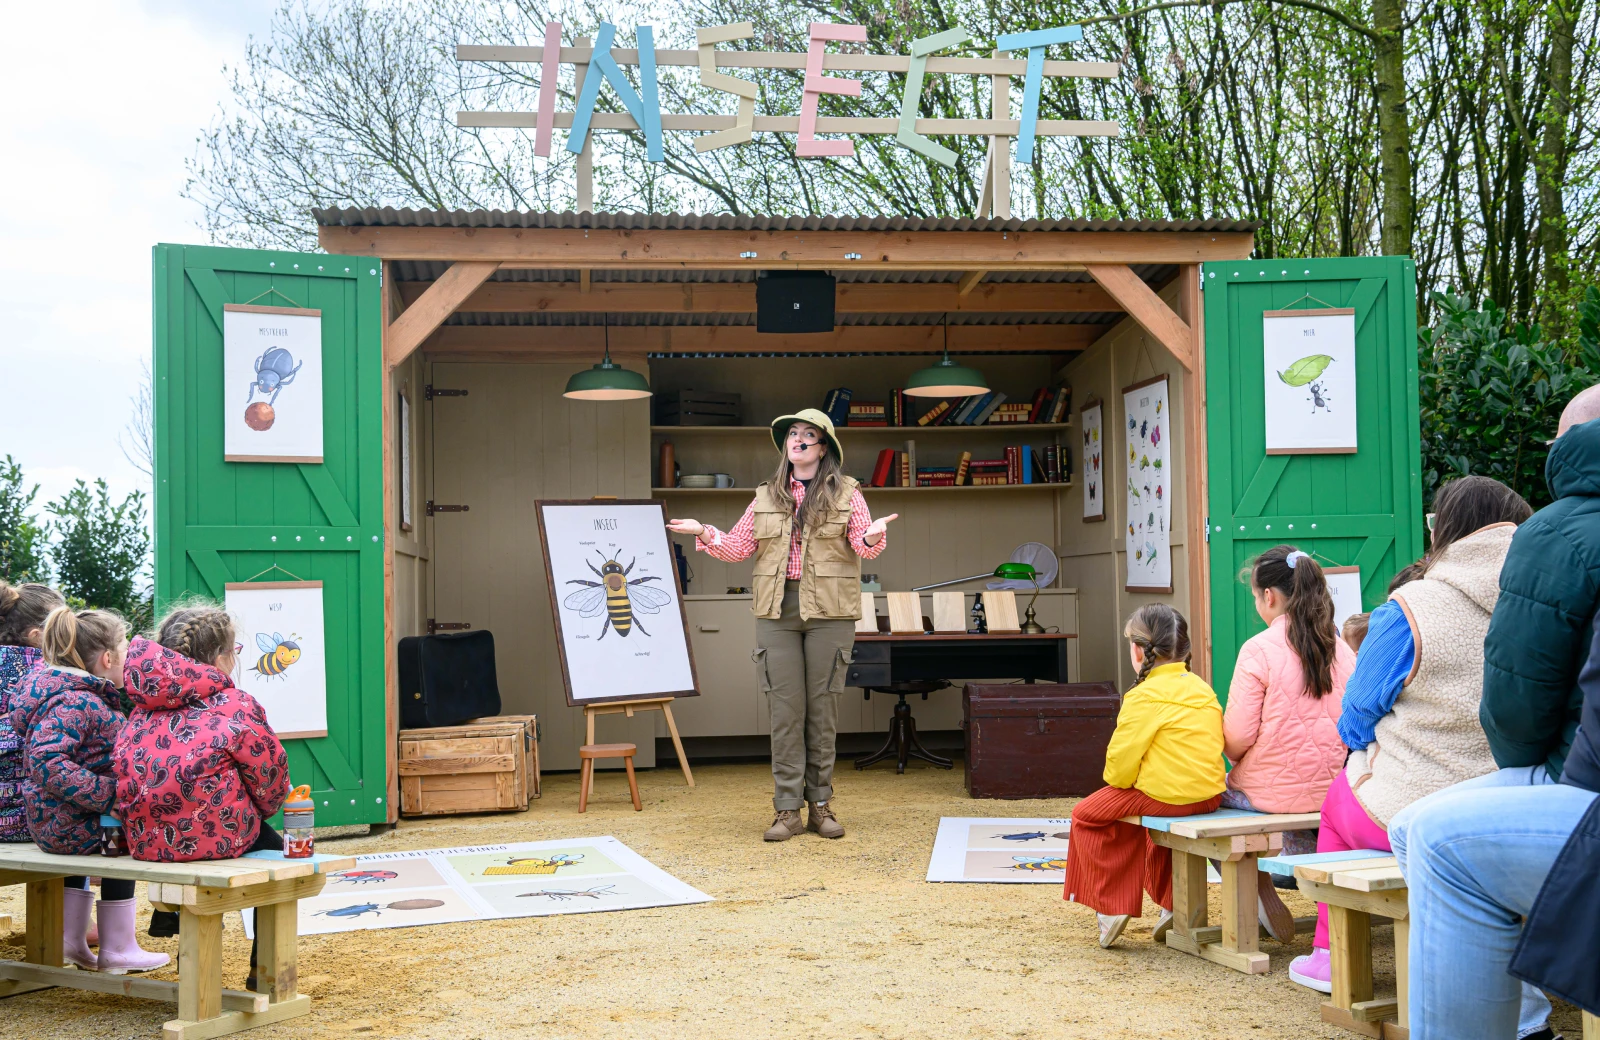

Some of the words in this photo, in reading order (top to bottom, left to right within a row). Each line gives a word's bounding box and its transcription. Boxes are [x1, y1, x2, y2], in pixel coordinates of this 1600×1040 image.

[534, 22, 1082, 168] INSECT
[258, 328, 288, 336] MESTKEVER
[1304, 328, 1316, 336] MIER
[594, 518, 618, 530] INSECT
[268, 602, 282, 612] WESP
